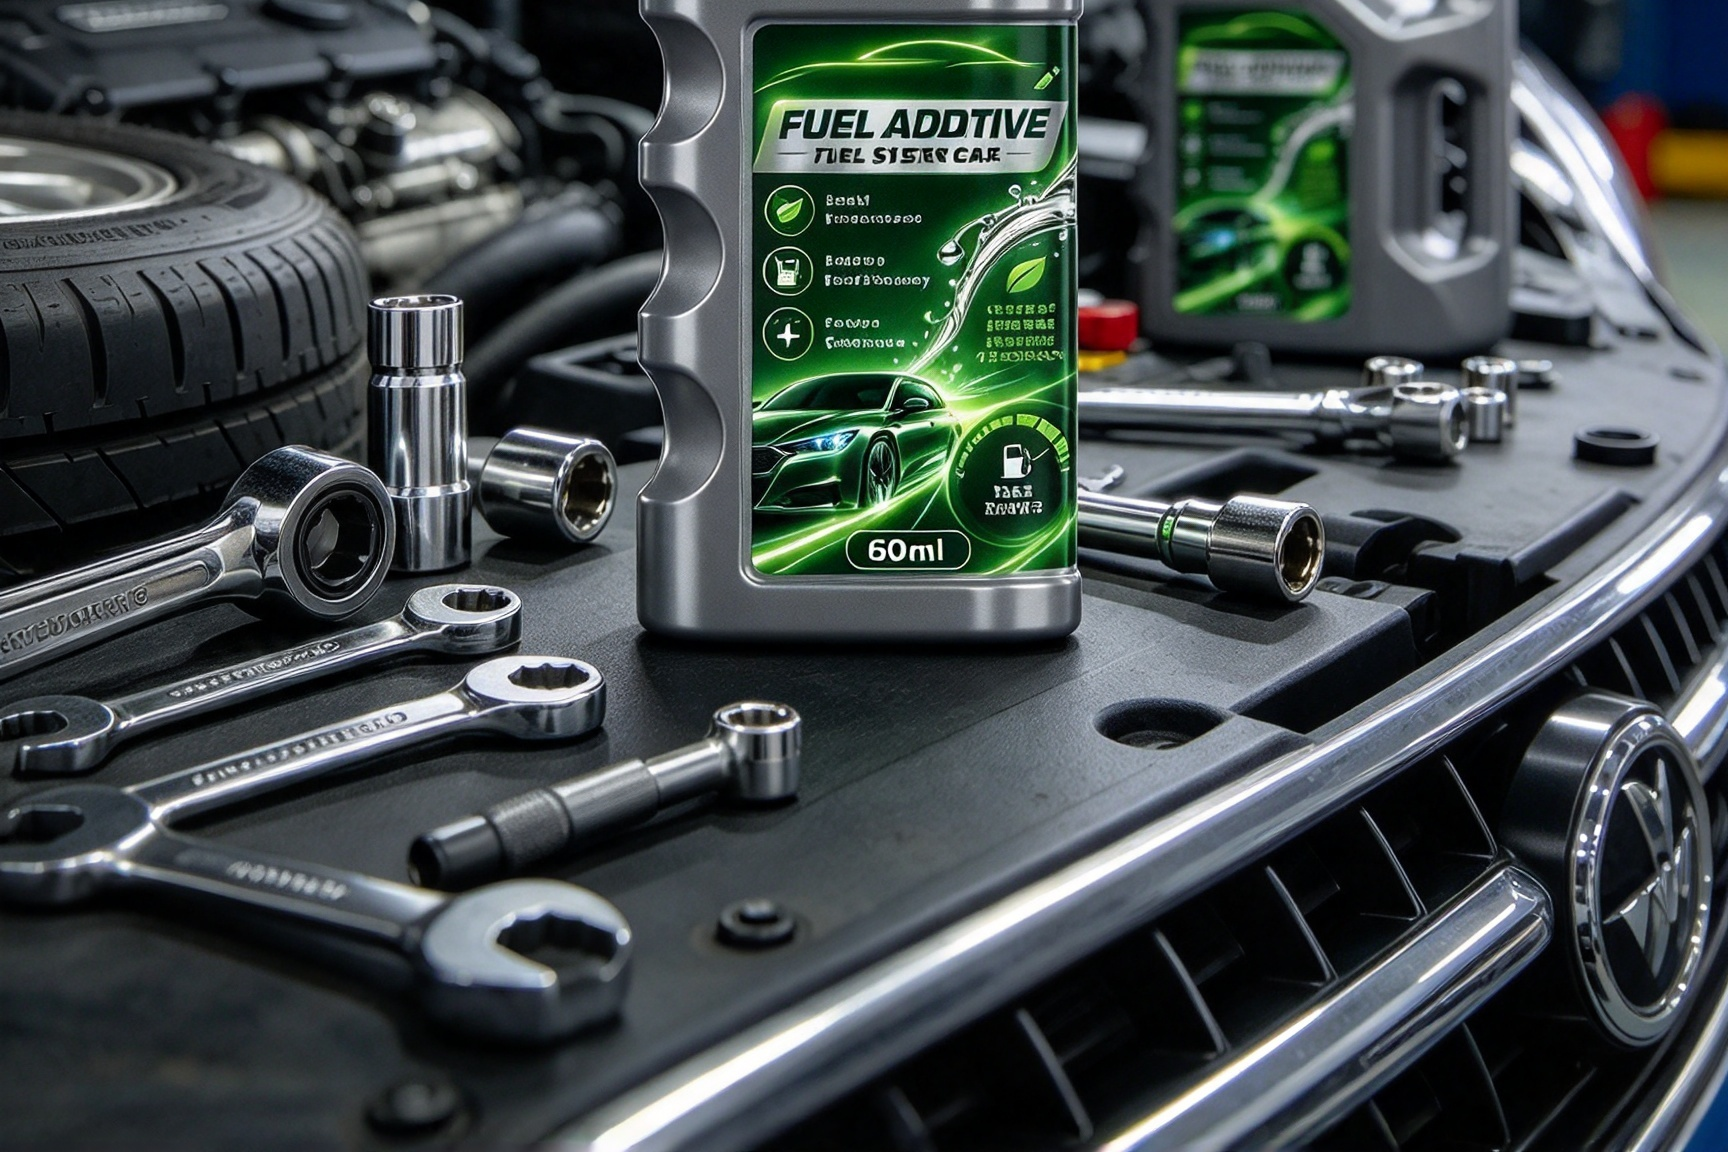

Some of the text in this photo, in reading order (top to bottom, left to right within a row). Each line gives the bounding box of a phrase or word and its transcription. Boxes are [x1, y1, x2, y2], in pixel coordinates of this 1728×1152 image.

[778, 107, 1052, 140] FUEL ADDTIVE
[868, 538, 944, 562] 60ml
